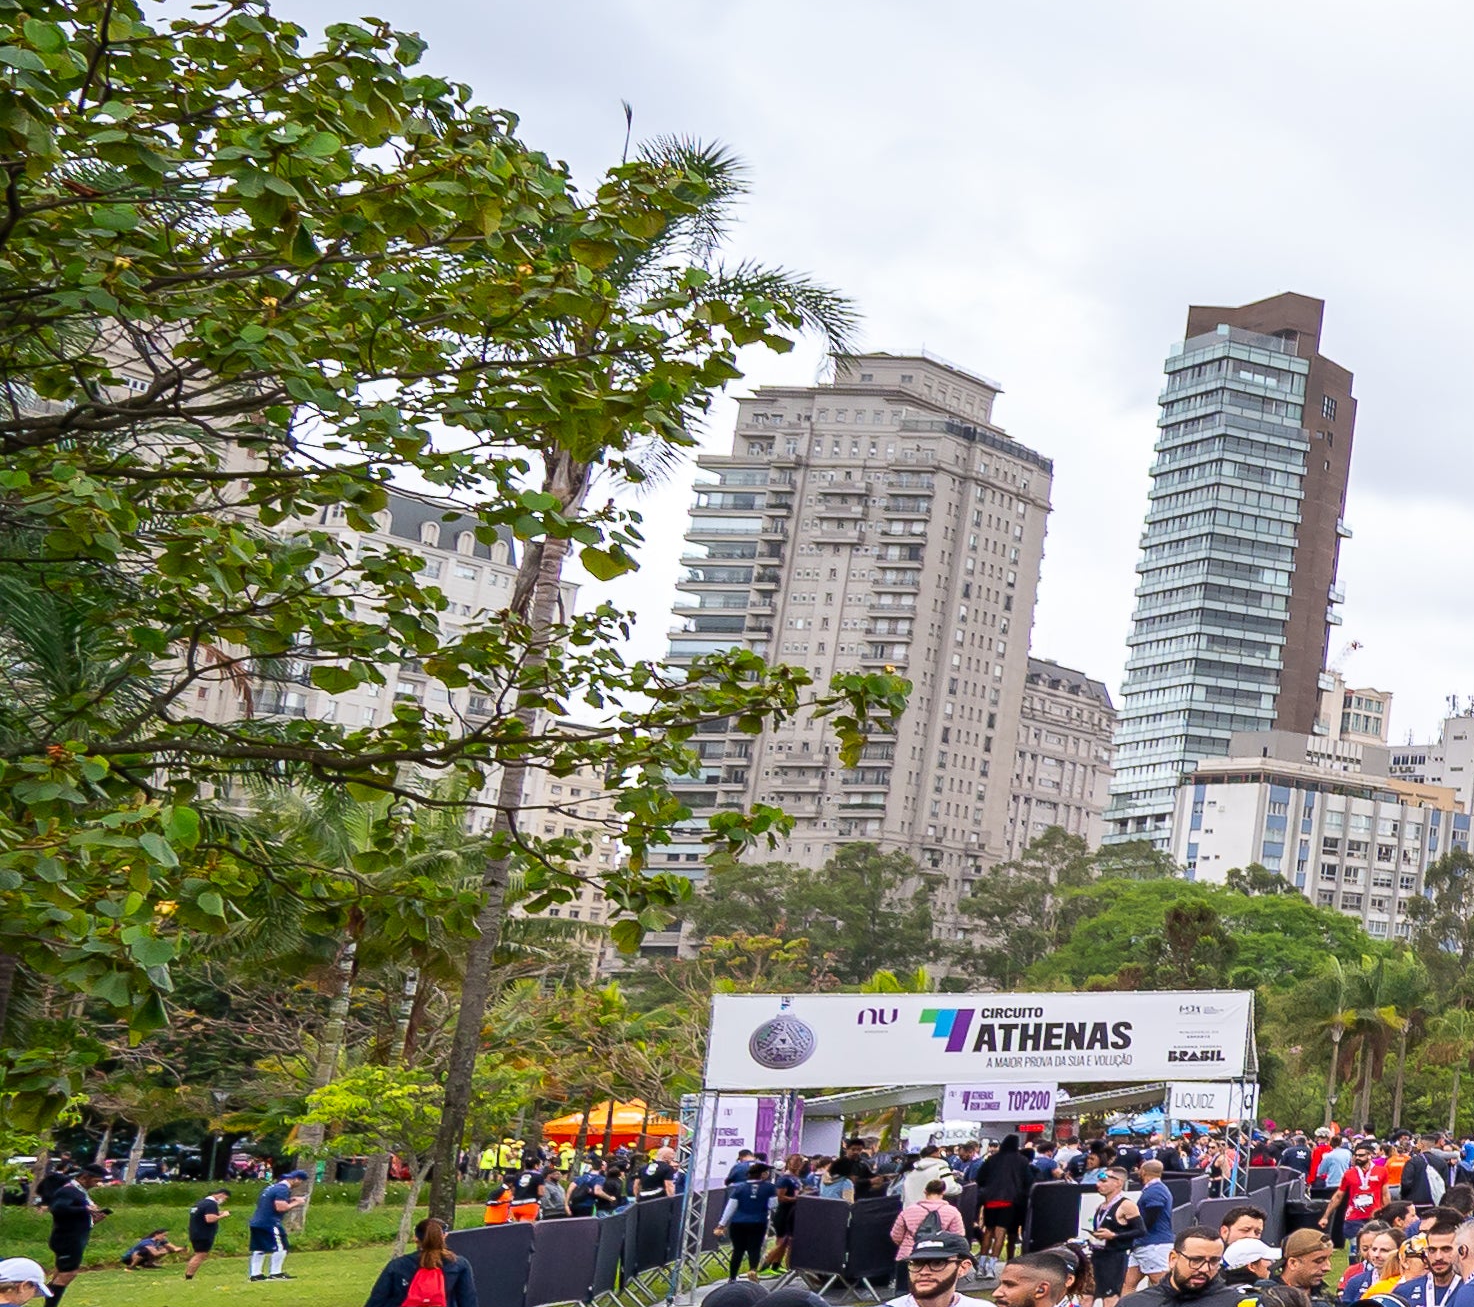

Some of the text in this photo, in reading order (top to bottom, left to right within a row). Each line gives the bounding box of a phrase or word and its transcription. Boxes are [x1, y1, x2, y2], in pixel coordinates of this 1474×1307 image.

[981, 1007, 1044, 1020] CIRCUITO
[972, 1021, 1133, 1053] ATHENAS
[994, 1056, 1023, 1069] MAIOR
[1024, 1055, 1053, 1068] PROVA
[1054, 1055, 1066, 1067] DA
[1067, 1054, 1085, 1067] SUA
[1007, 1090, 1051, 1111] TOP200
[1175, 1092, 1216, 1110] LIQUIDZ
